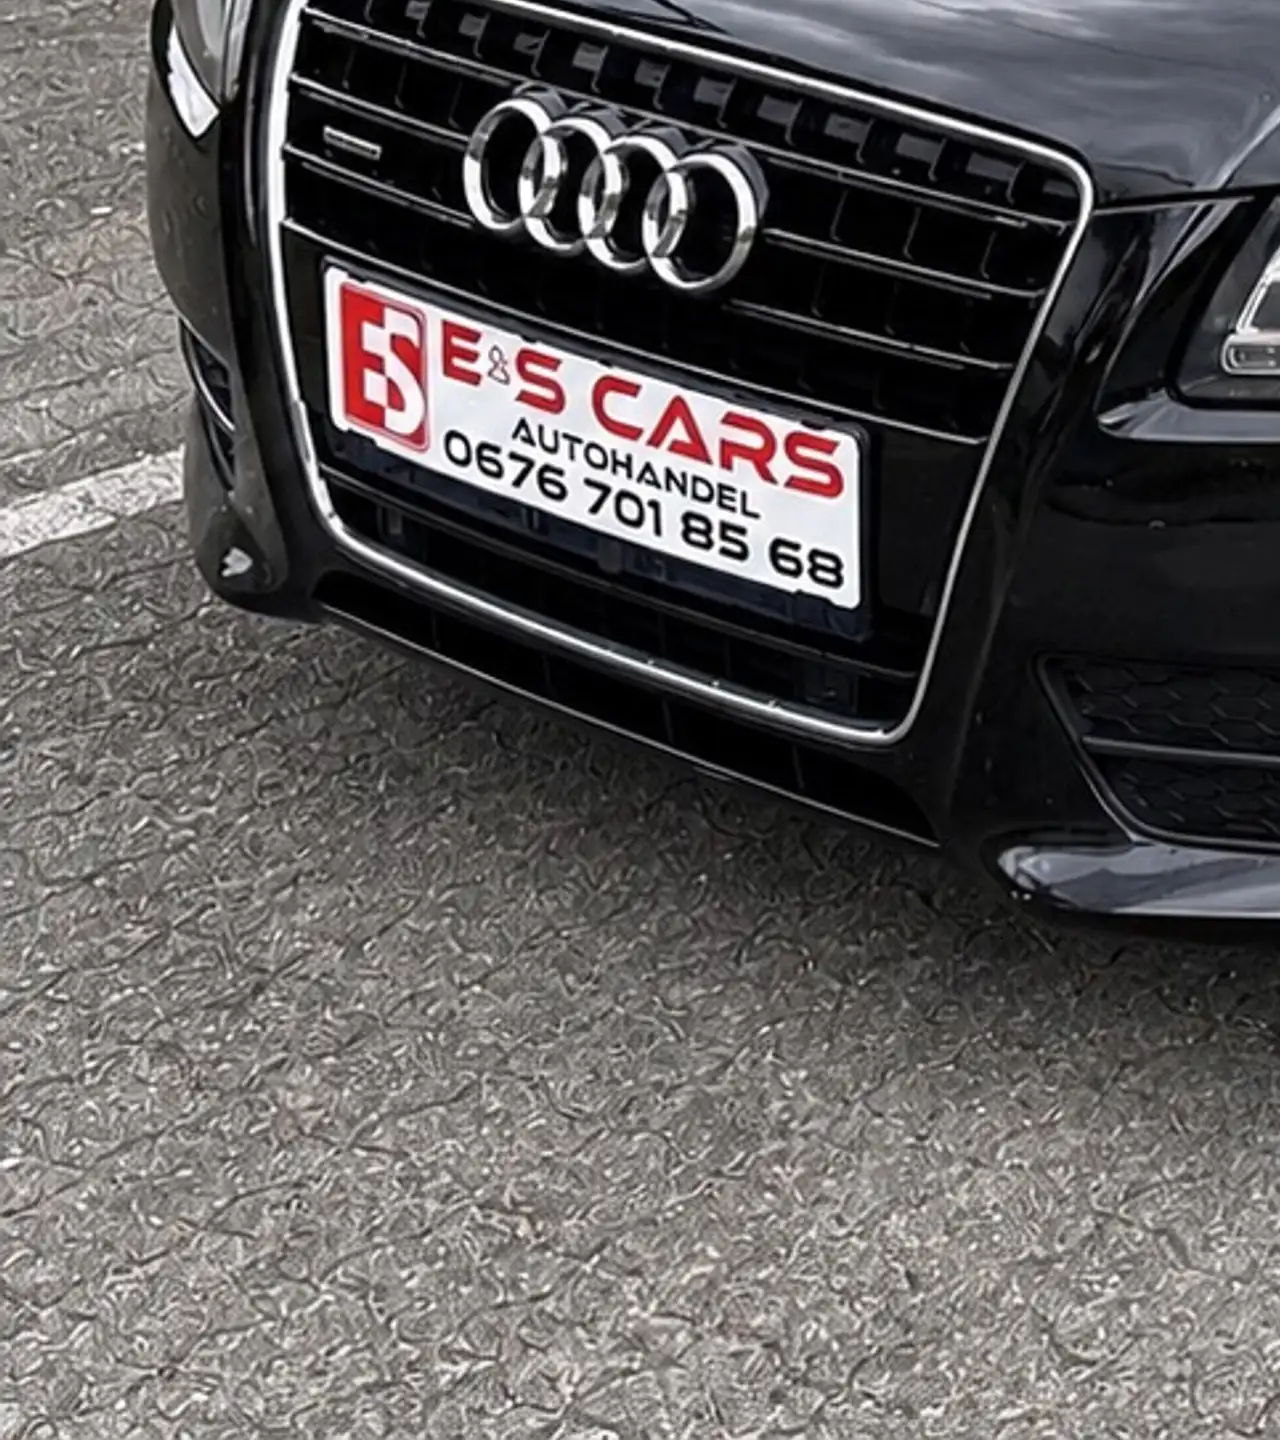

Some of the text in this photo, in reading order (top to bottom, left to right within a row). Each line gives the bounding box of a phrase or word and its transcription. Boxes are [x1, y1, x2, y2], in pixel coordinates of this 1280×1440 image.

[441, 320, 844, 498] E&S CARS
[512, 418, 760, 519] AUTOHANDEL
[444, 430, 844, 589] 0676 701 85 68
